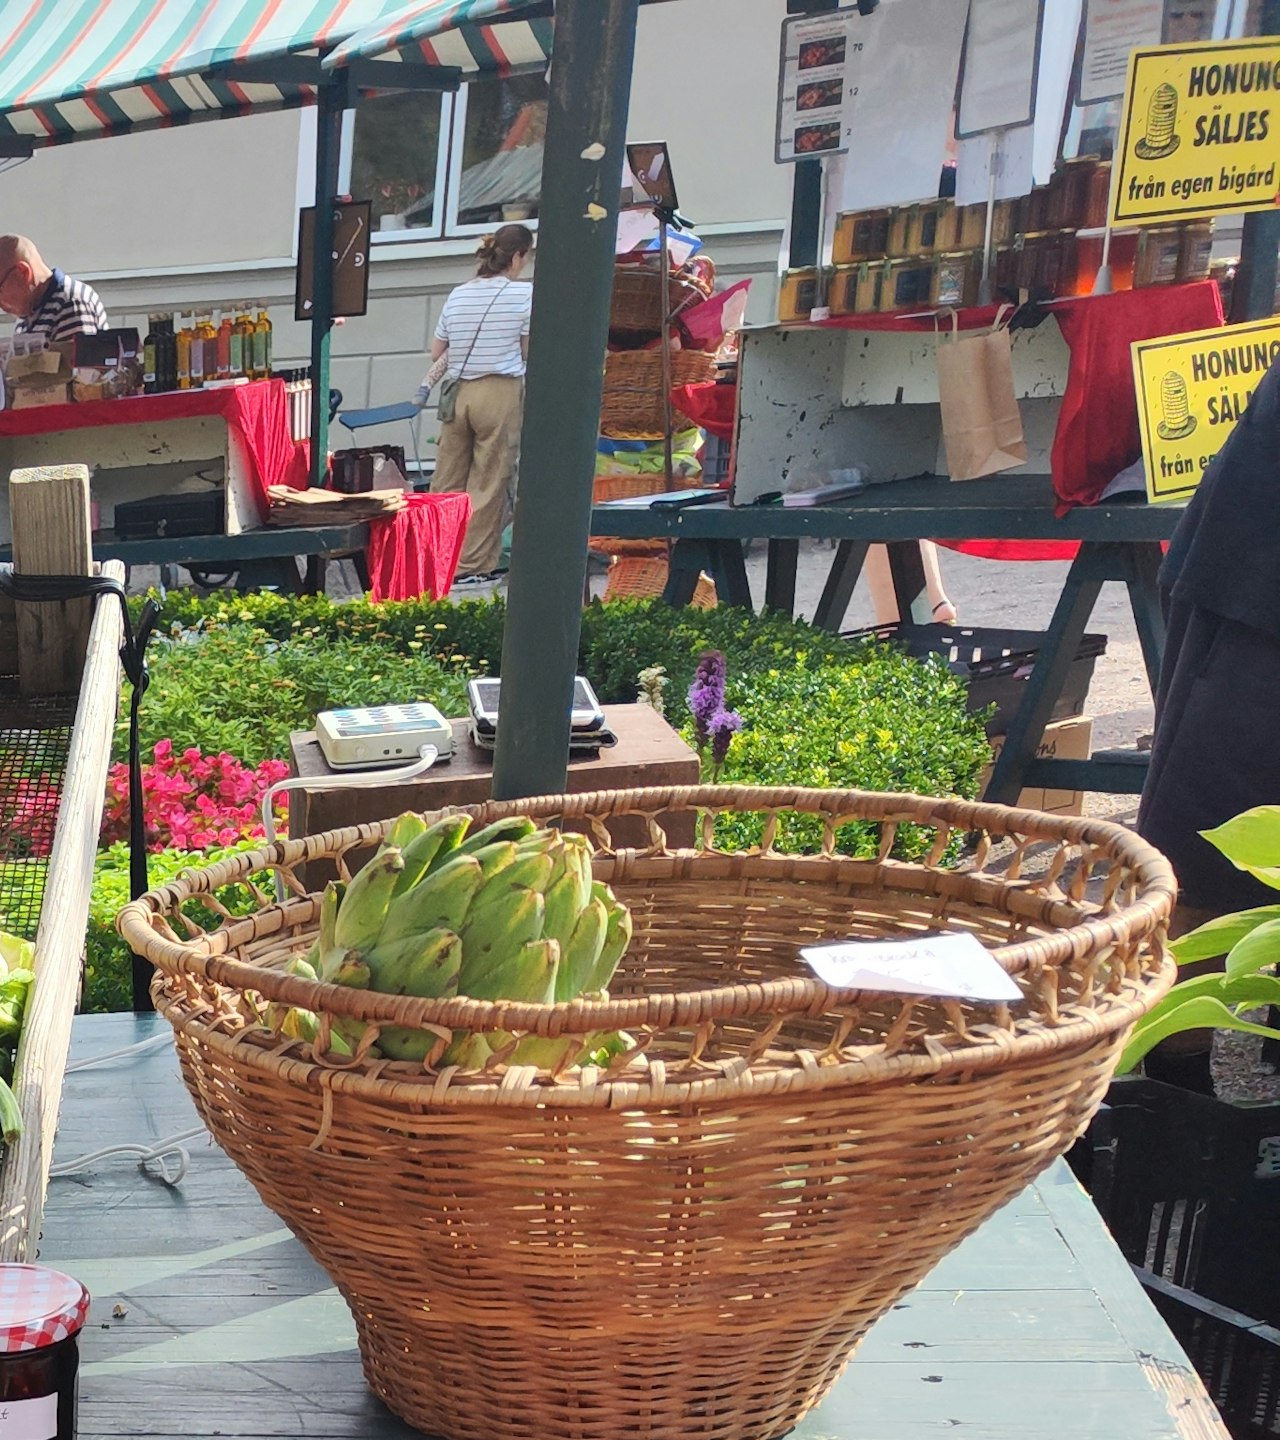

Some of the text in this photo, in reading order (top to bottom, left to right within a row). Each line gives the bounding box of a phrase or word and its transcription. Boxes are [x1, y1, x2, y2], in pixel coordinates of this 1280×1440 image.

[1192, 104, 1270, 147] SÄLJES
[1128, 161, 1276, 201] från egen bigård
[1160, 452, 1194, 478] från
